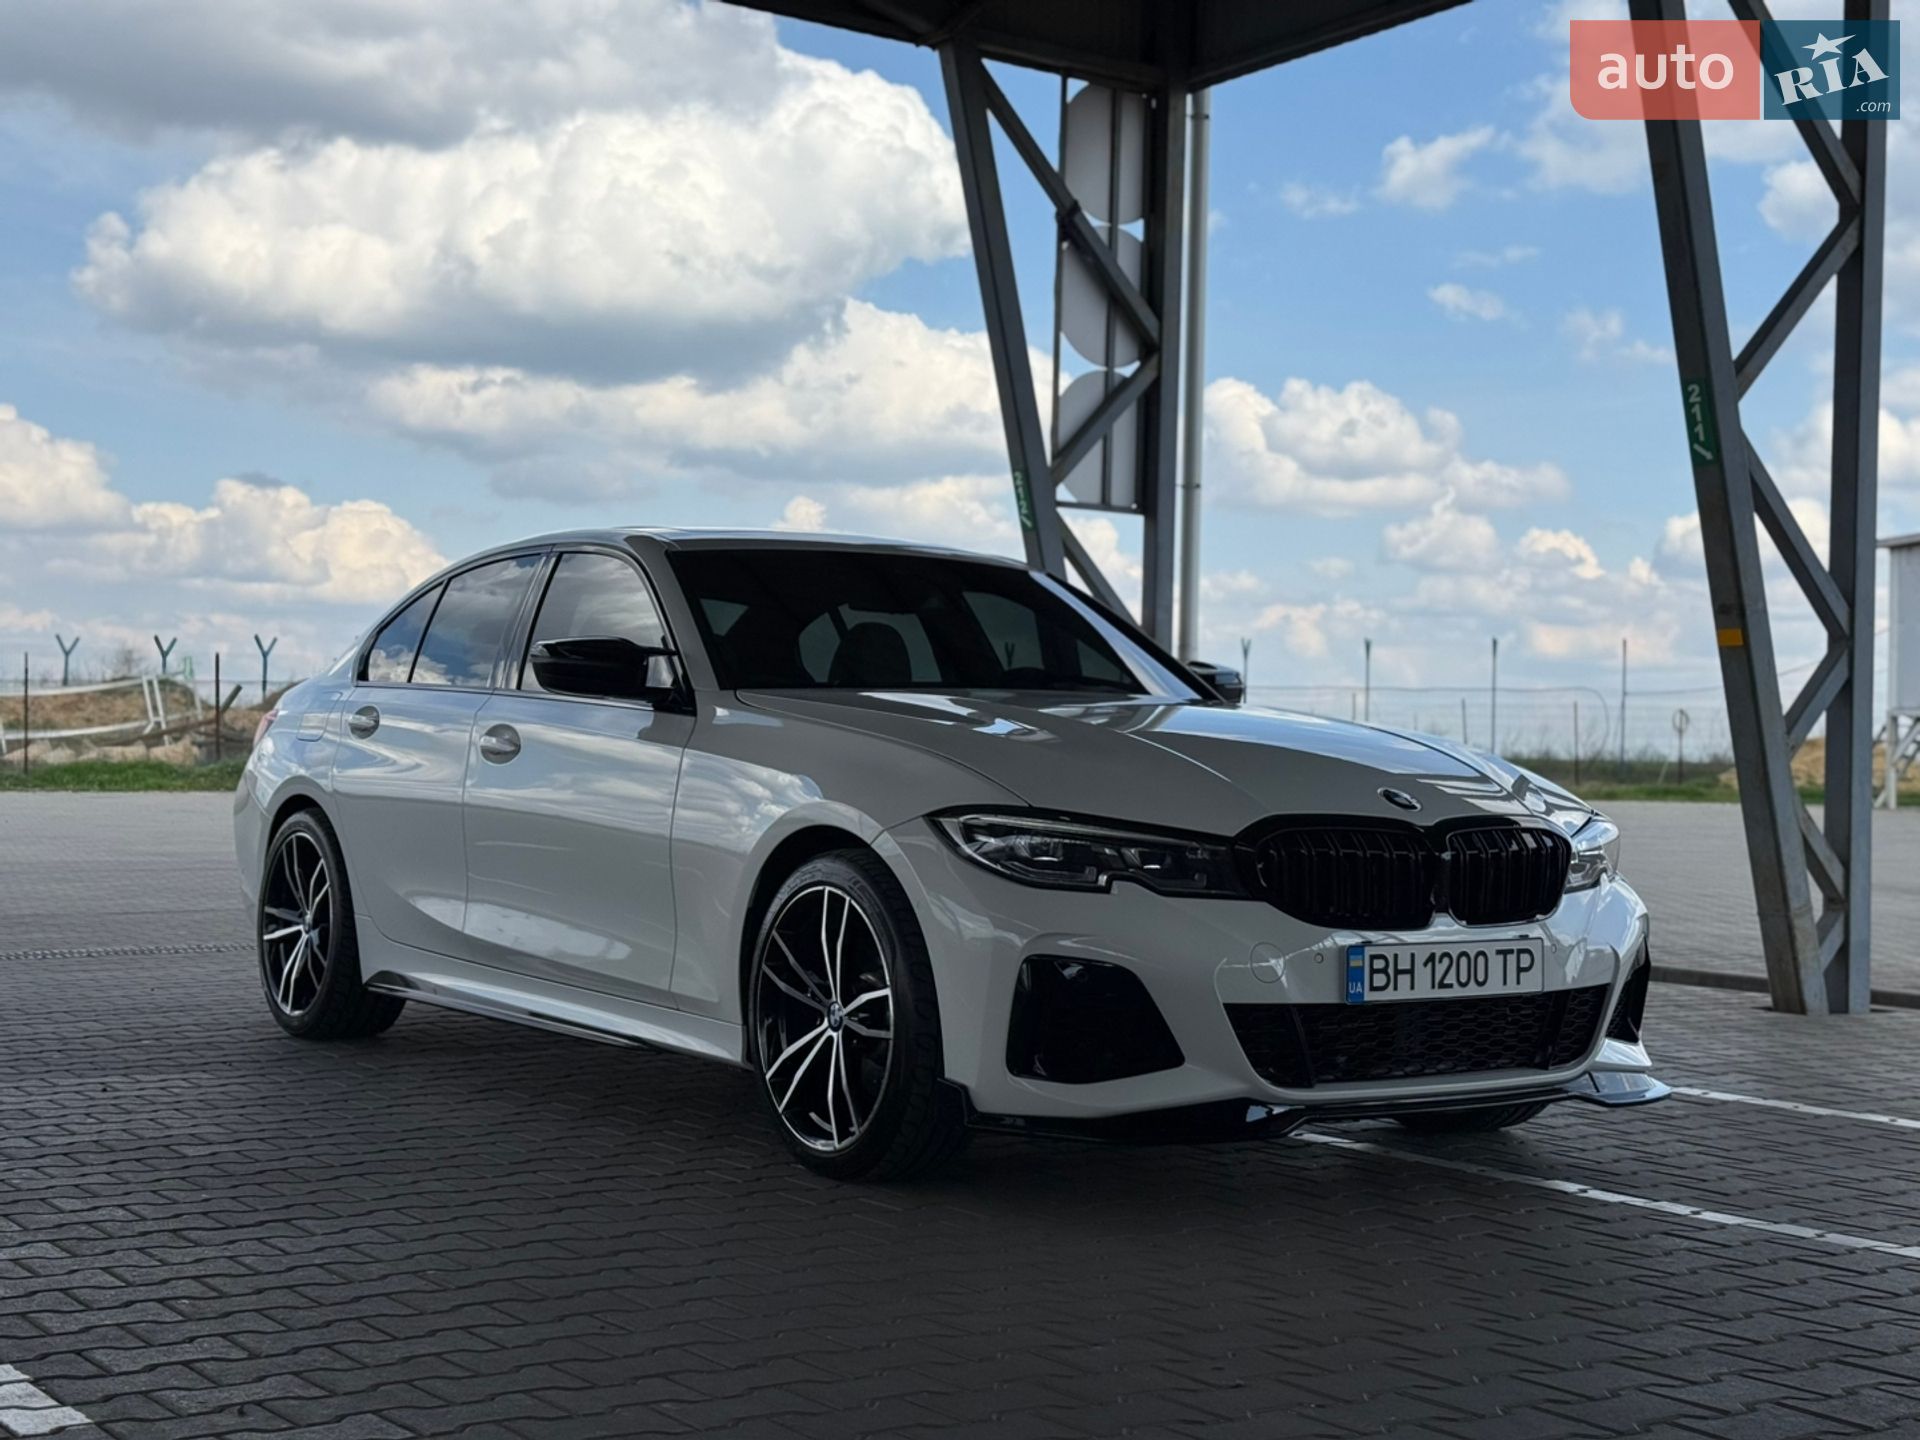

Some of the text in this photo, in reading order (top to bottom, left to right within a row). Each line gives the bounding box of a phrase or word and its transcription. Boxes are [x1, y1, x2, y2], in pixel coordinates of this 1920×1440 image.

[1687, 383, 1705, 442] 211
[1349, 981, 1363, 994] UA
[1368, 948, 1536, 992] BH 1200 TP
